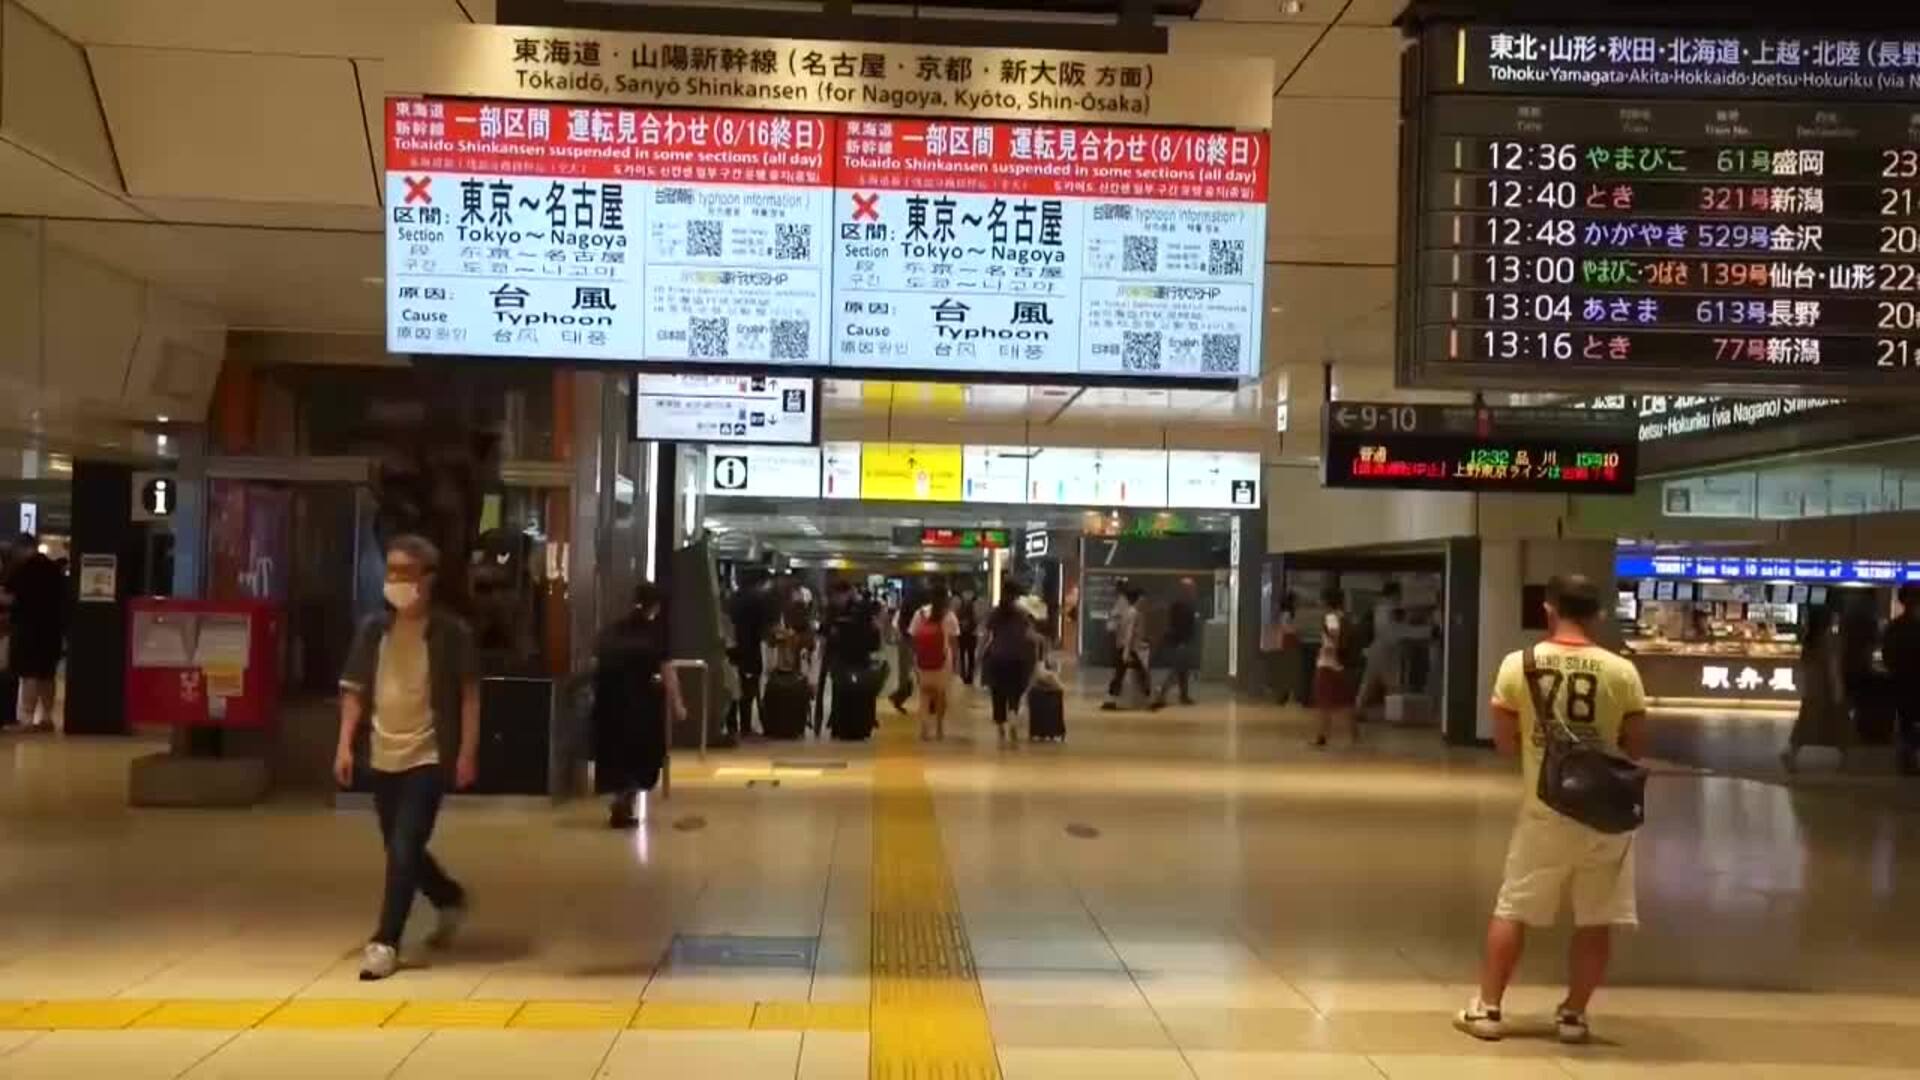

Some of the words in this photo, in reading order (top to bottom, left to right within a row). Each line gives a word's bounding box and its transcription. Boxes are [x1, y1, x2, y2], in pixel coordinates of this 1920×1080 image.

[516, 70, 609, 93] Tōkaidō,
[616, 74, 680, 98] Sanyō
[687, 75, 807, 99] Shinkansen
[818, 81, 855, 102] (for
[864, 85, 947, 108] Nagoya,
[955, 89, 1021, 111] Kyōto,
[1878, 71, 1904, 90] (via
[455, 106, 549, 139] 一部区間
[394, 137, 453, 151] Tokaido
[458, 140, 545, 156] Shinkansen
[550, 143, 630, 158] suspended
[635, 149, 648, 159] in
[654, 150, 693, 161] some
[699, 151, 758, 163] sections
[763, 153, 786, 165] (all
[790, 153, 822, 167] day)
[902, 124, 993, 157] 一部区間
[843, 156, 900, 170] Tokaido
[905, 157, 988, 173] Shinkansen
[992, 161, 1070, 176] suspended
[1075, 164, 1088, 176] in
[1093, 166, 1133, 178] some
[1136, 167, 1194, 180] sections
[1200, 169, 1221, 182] (all
[1225, 170, 1256, 185] day)
[1489, 142, 1577, 171] 12:36
[1585, 145, 1688, 171] やまびこ
[1717, 149, 1770, 172] 61号
[1771, 149, 1824, 176] 盛岡
[1489, 180, 1576, 209] 12:40
[1587, 184, 1633, 209] とき
[1770, 187, 1824, 214] 新潟
[398, 227, 444, 242] Section
[1487, 217, 1576, 246] 12:48
[1584, 222, 1688, 247] かがやき
[1699, 225, 1769, 248] 529号
[1769, 224, 1823, 251] 金沢
[1880, 226, 1920, 253] 20
[845, 244, 889, 259] Section
[1486, 255, 1574, 284] 13:00
[1701, 262, 1768, 286] 139号
[1769, 262, 1876, 290] 仙台・山形
[1879, 264, 1920, 291] 22
[402, 309, 448, 323] Cause
[493, 311, 612, 326] Typhoon
[1486, 293, 1572, 322] 13:04
[1583, 297, 1659, 322] あさま
[1697, 300, 1767, 324] 613号
[1768, 300, 1820, 327] 長野
[1878, 302, 1920, 329] 20
[847, 324, 890, 338] Cause
[936, 325, 1049, 340] Typhoon
[1484, 331, 1572, 359] 13:16
[1583, 335, 1631, 359] とき
[1713, 338, 1767, 361] 77号
[1767, 337, 1820, 365] 新潟
[1712, 407, 1732, 428] (via
[1733, 399, 1780, 425] Nagano)
[1104, 540, 1118, 566] 7
